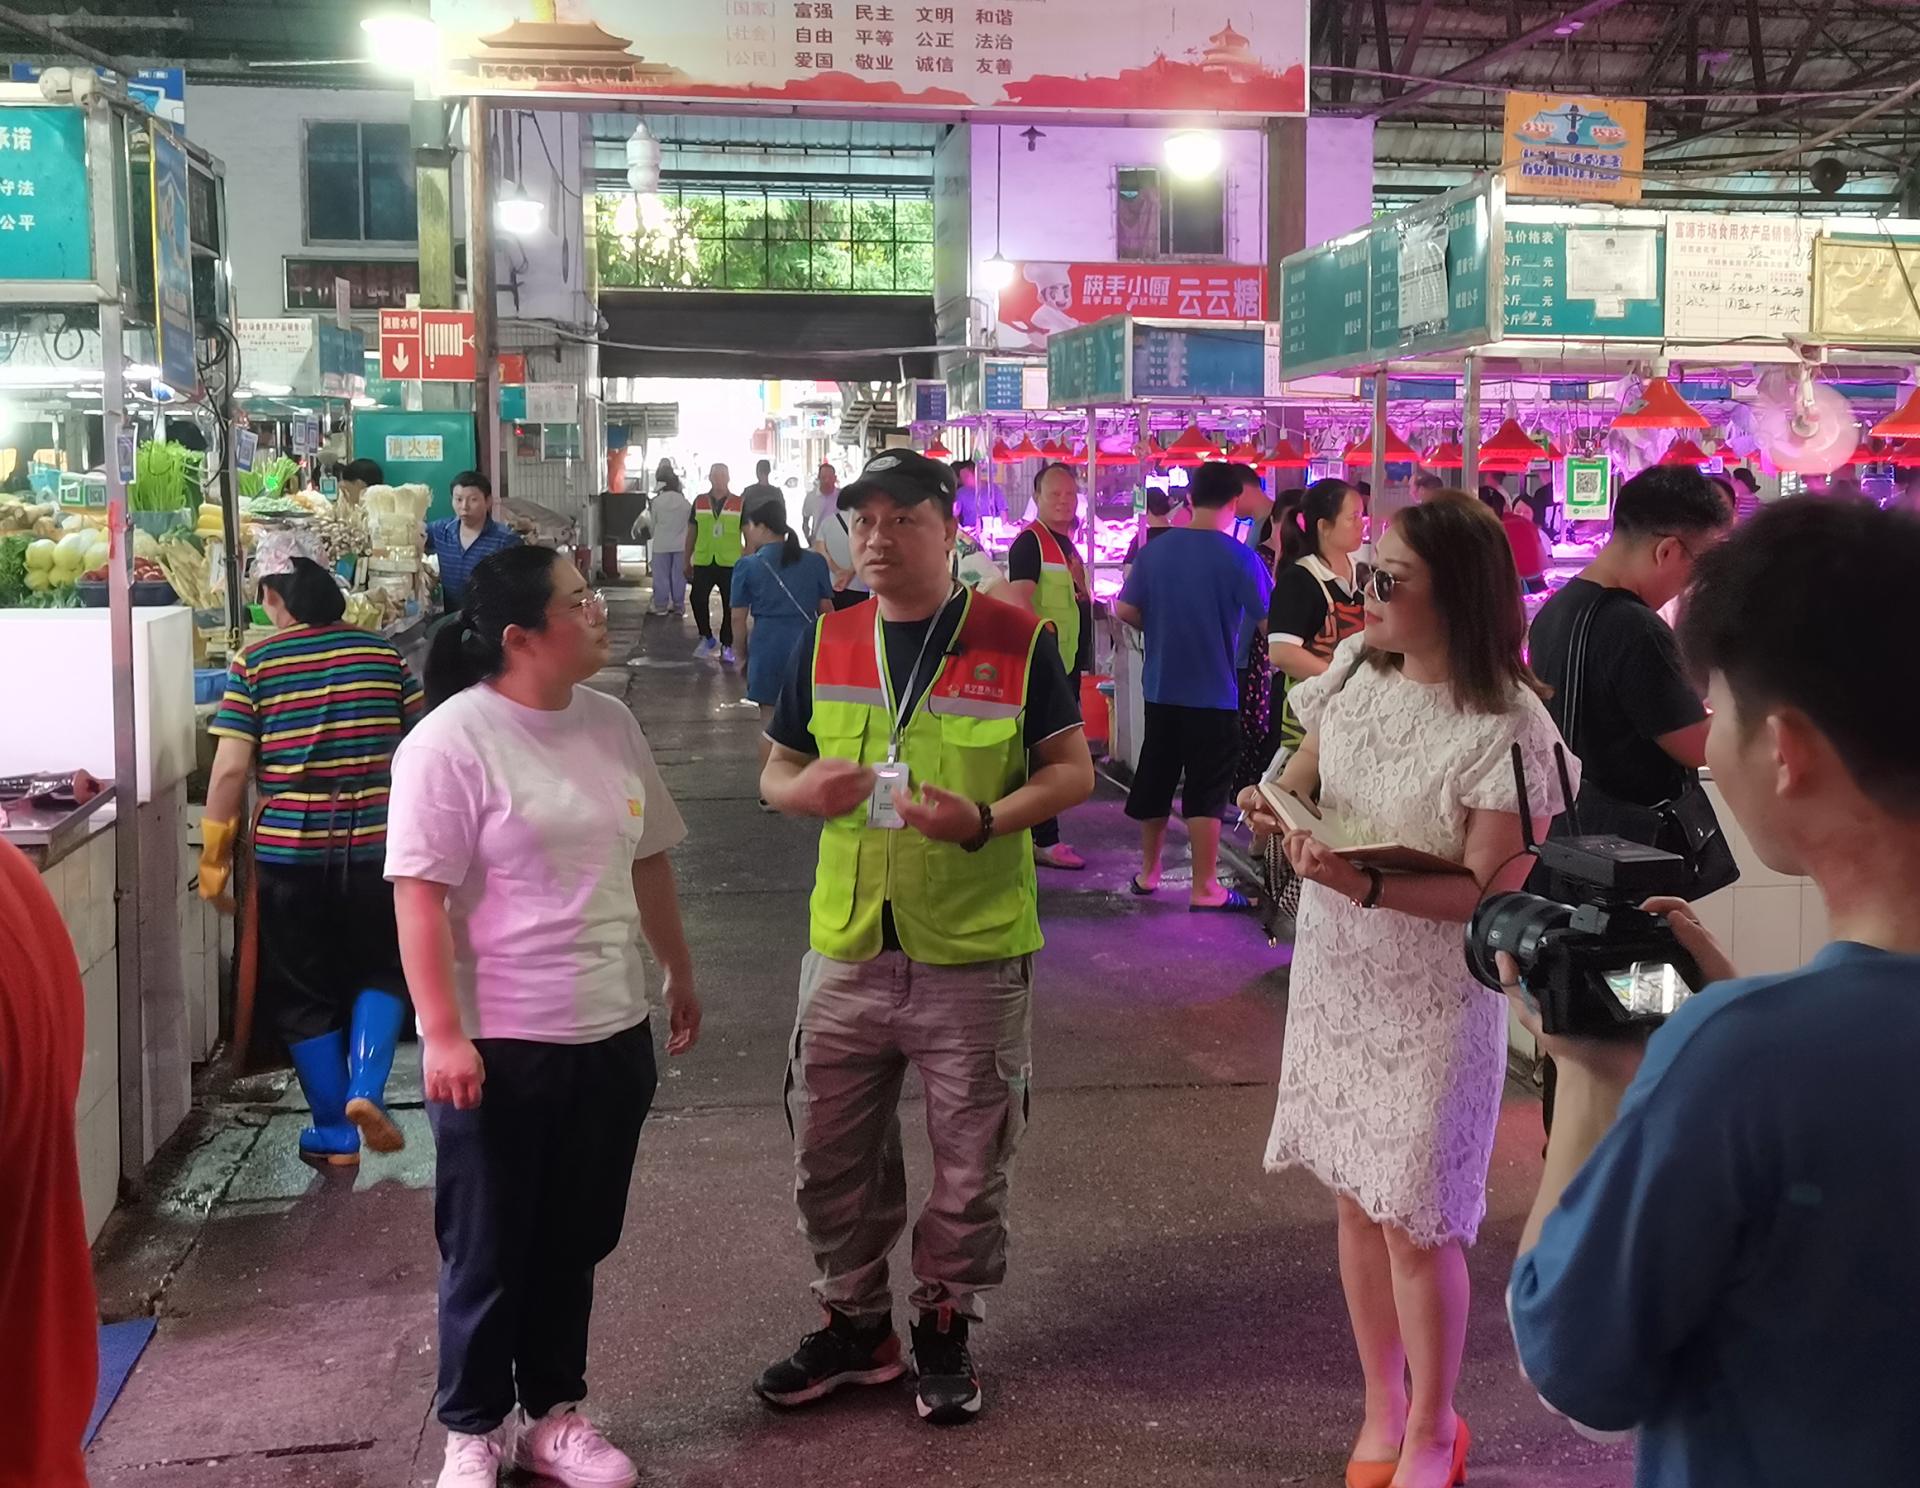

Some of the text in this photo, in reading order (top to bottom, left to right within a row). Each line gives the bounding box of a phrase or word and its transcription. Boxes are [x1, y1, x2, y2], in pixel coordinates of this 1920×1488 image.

[793, 1, 834, 20] 富强
[855, 3, 895, 22] 民主
[915, 6, 954, 24] 文明
[975, 8, 1014, 27] 和谐
[795, 26, 833, 45] 自由
[855, 28, 894, 47] 平等
[915, 31, 954, 49] 公正
[975, 33, 1014, 51] 法治
[793, 51, 834, 69] 爱国
[854, 52, 894, 72] 敬业
[915, 55, 954, 74] 诚信
[975, 56, 1013, 75] 友善
[0, 213, 36, 232] 公平
[1543, 256, 1555, 268] 元
[1542, 275, 1554, 288] 元
[1177, 277, 1260, 318] 云云糖
[1542, 295, 1554, 307] 元
[1541, 315, 1553, 327] 元
[388, 437, 441, 456] 消火栓
